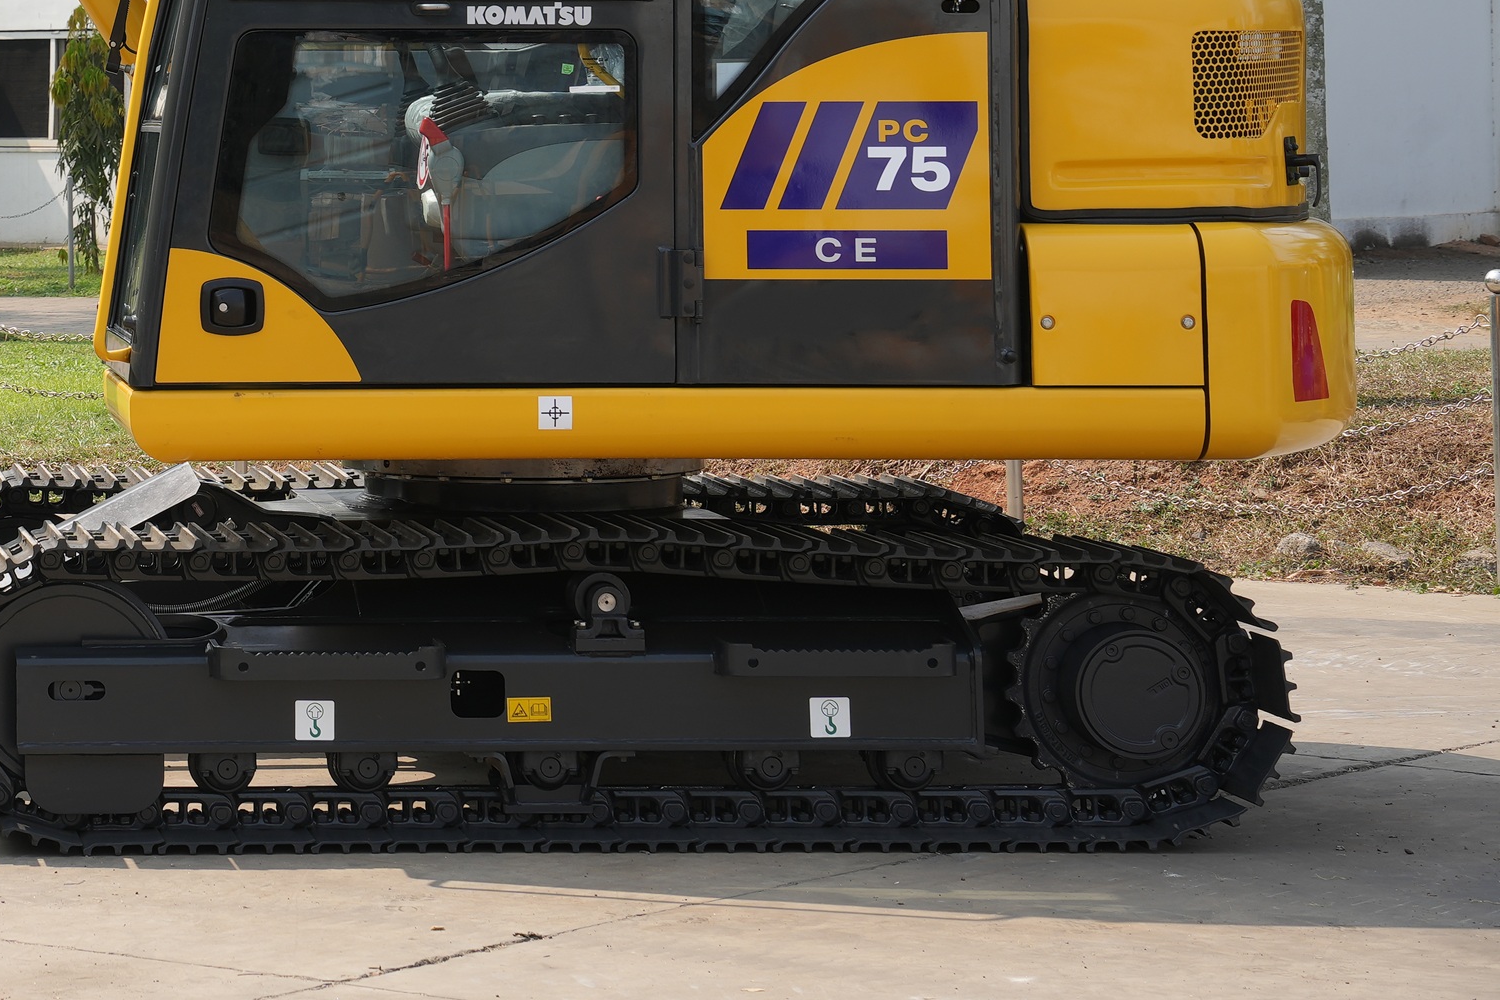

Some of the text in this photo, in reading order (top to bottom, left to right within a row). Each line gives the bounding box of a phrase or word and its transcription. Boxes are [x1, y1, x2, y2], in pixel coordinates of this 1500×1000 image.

[466, 1, 592, 26] KOMATSU
[877, 119, 929, 142] PC
[867, 146, 951, 192] 75
